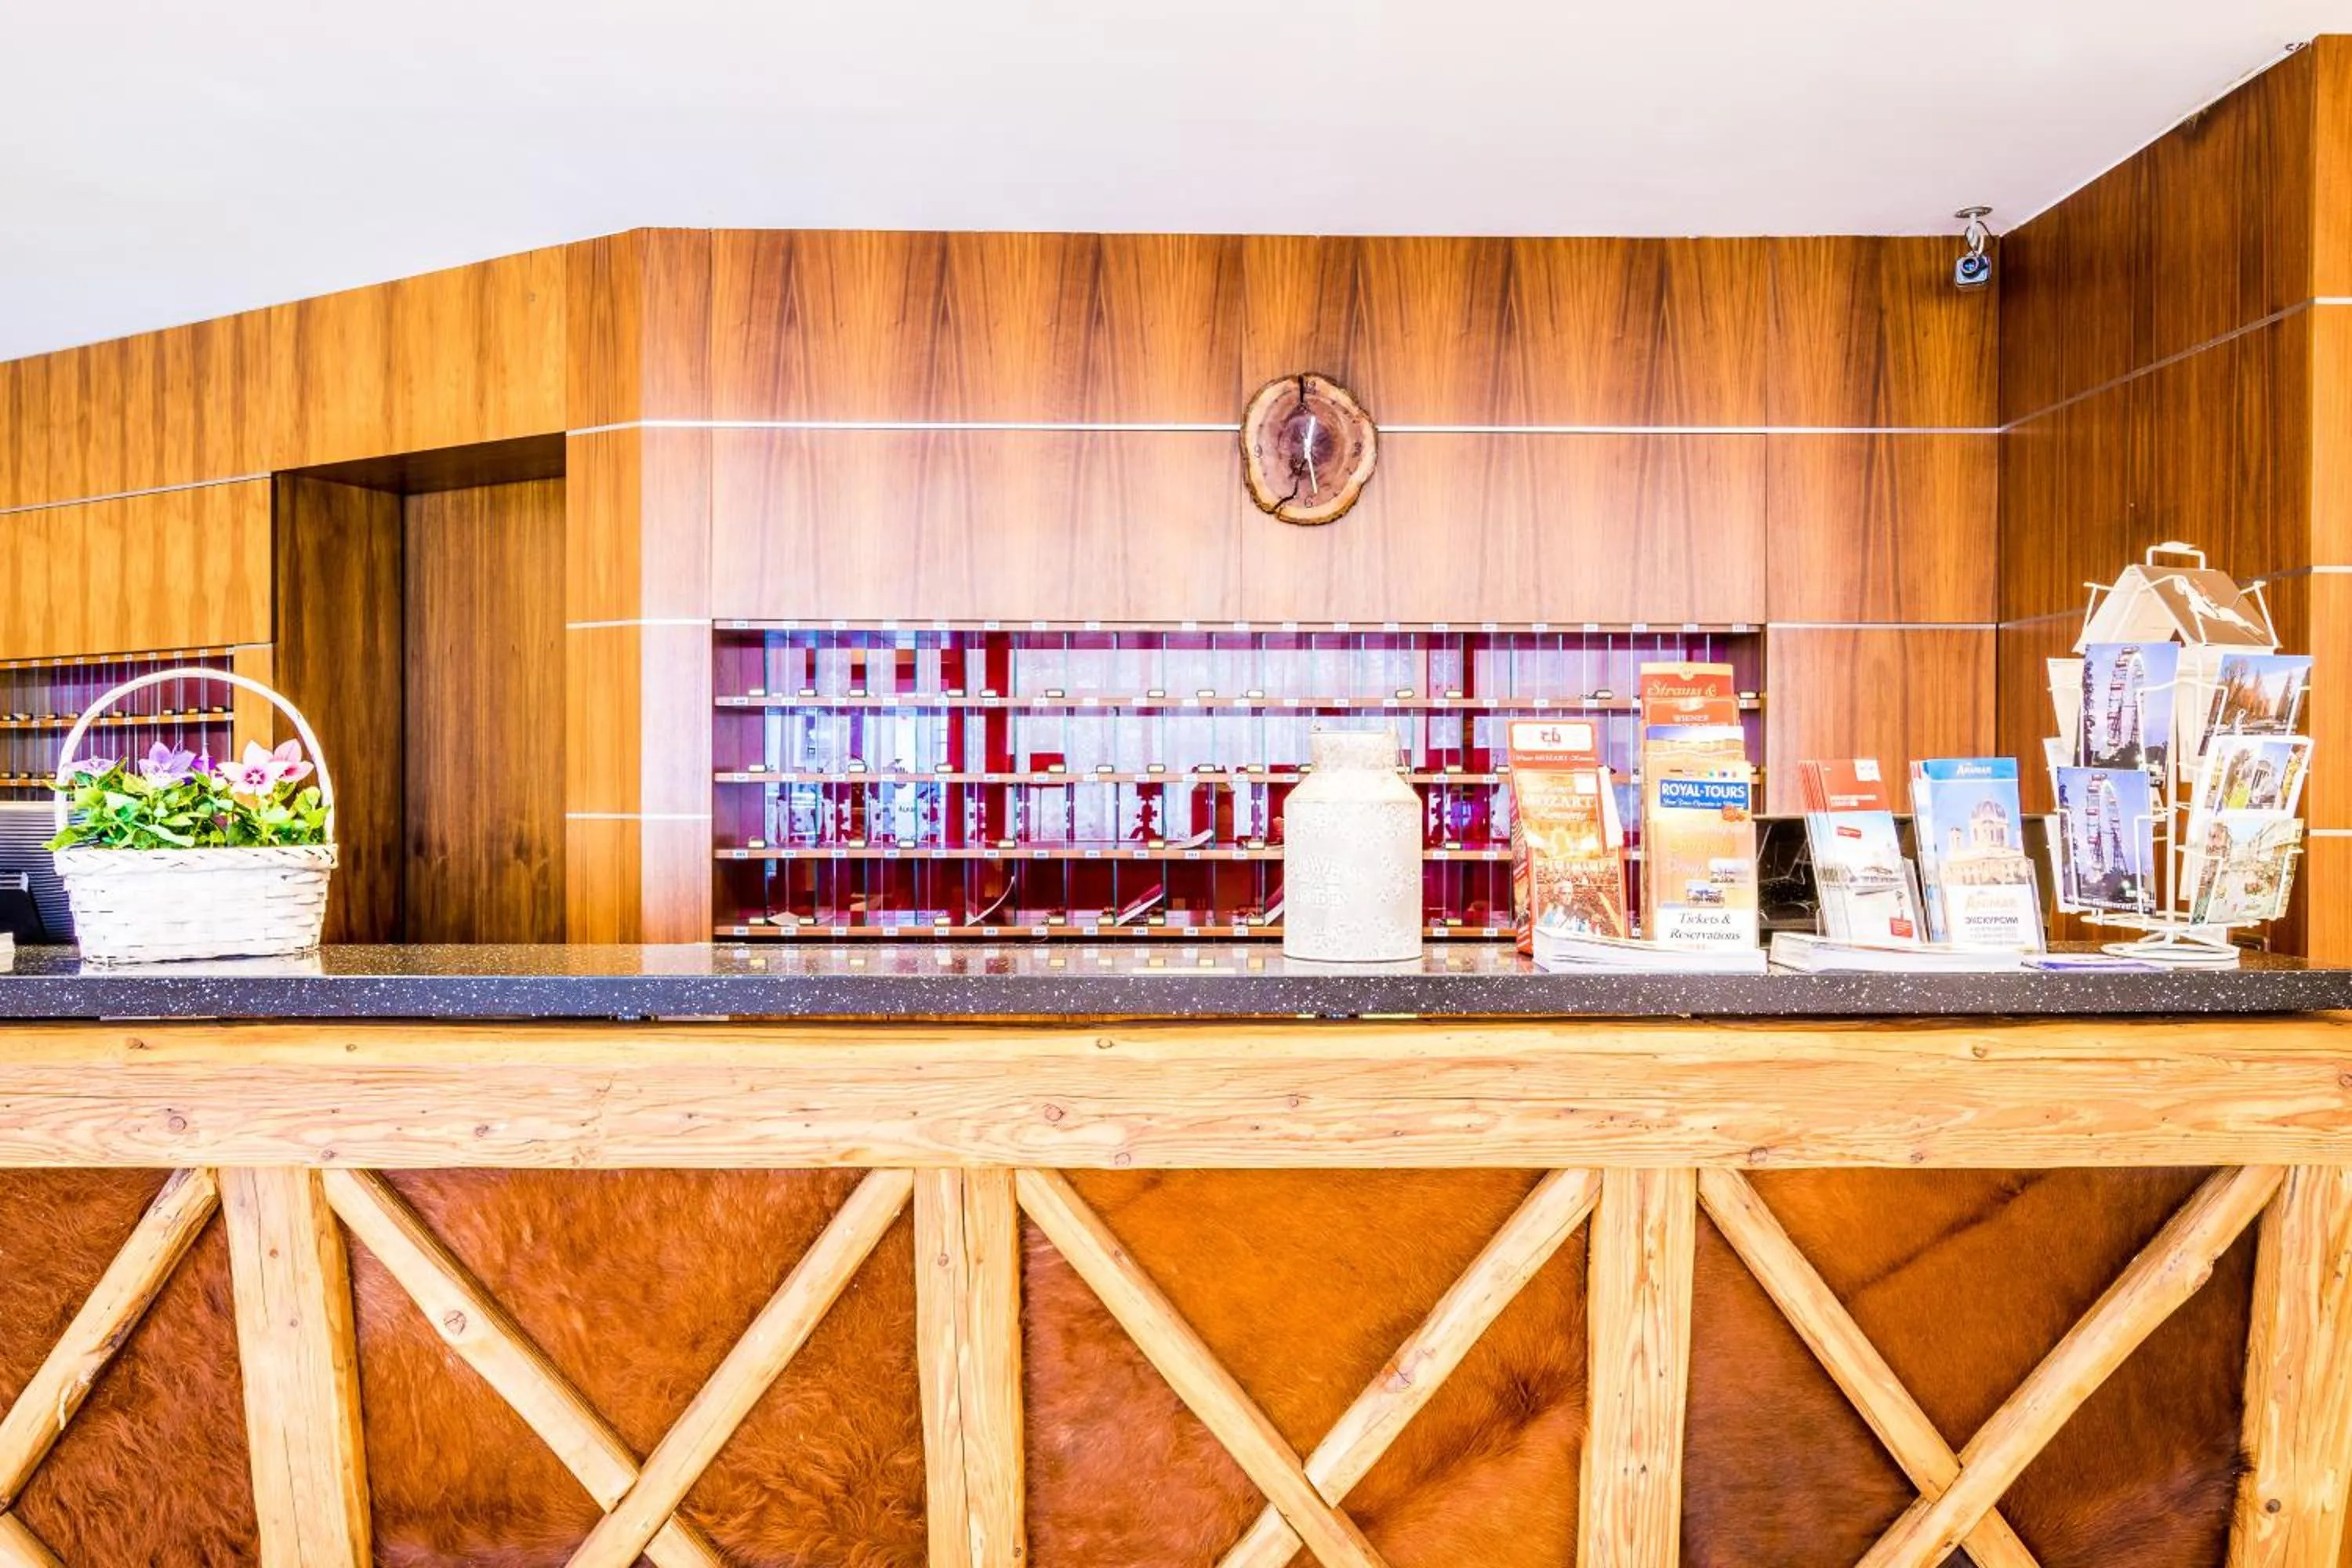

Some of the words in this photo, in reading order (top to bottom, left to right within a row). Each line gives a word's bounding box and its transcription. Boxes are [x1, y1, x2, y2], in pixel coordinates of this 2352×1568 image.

[1661, 782, 1745, 798] ROYAL-TOURS
[1679, 912, 1720, 925] Tickets
[1721, 913, 1731, 924] &
[1964, 916, 2020, 925] ЭКСКУРСИИ
[1669, 927, 1741, 942] Reservations
